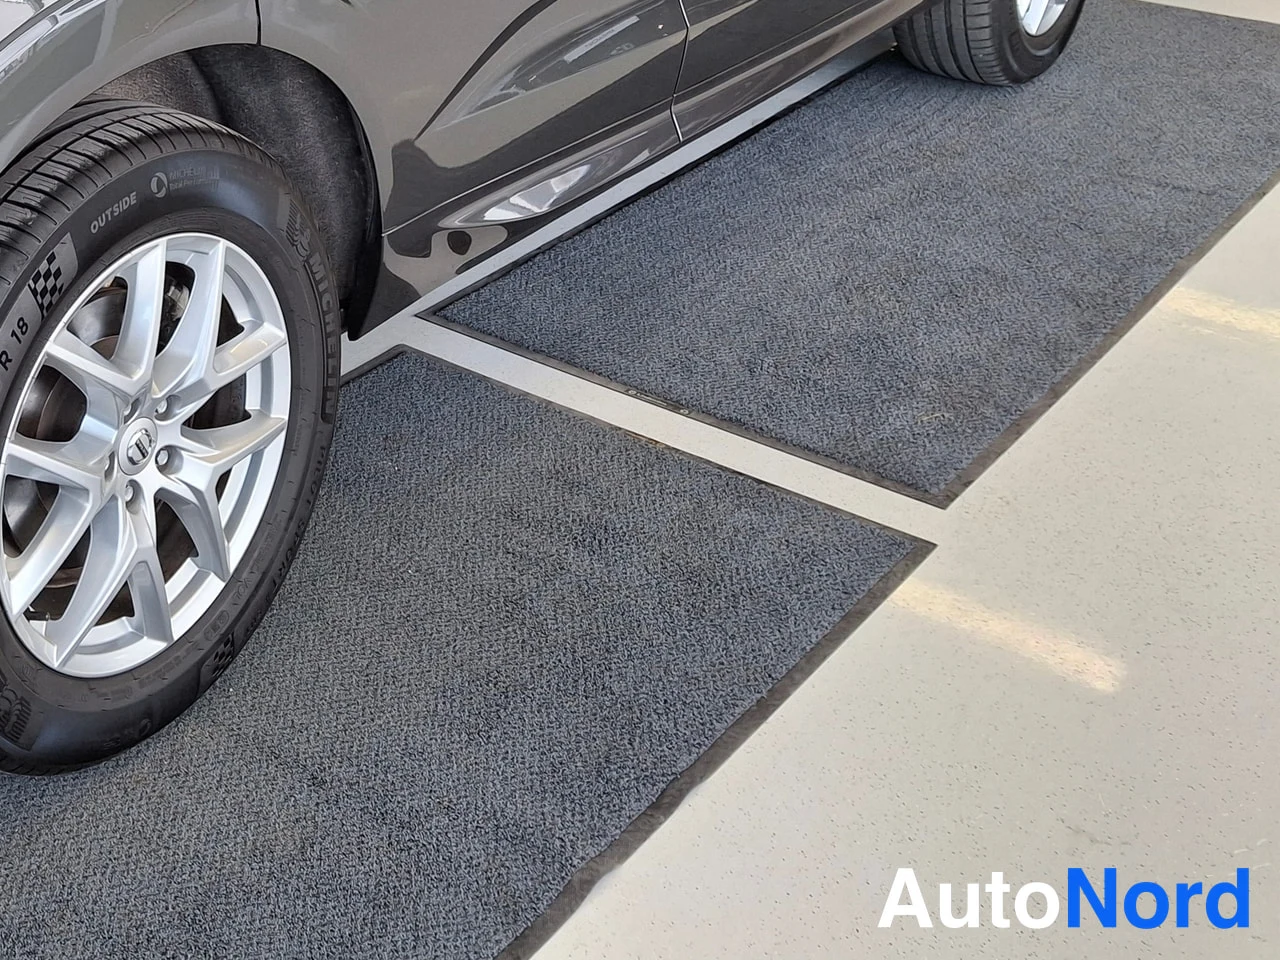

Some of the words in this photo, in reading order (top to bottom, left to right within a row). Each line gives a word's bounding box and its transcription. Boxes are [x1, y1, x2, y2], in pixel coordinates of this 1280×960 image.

[90, 191, 138, 234] OUTSIDE
[10, 316, 29, 345] 18
[309, 251, 337, 414] MICHELIN
